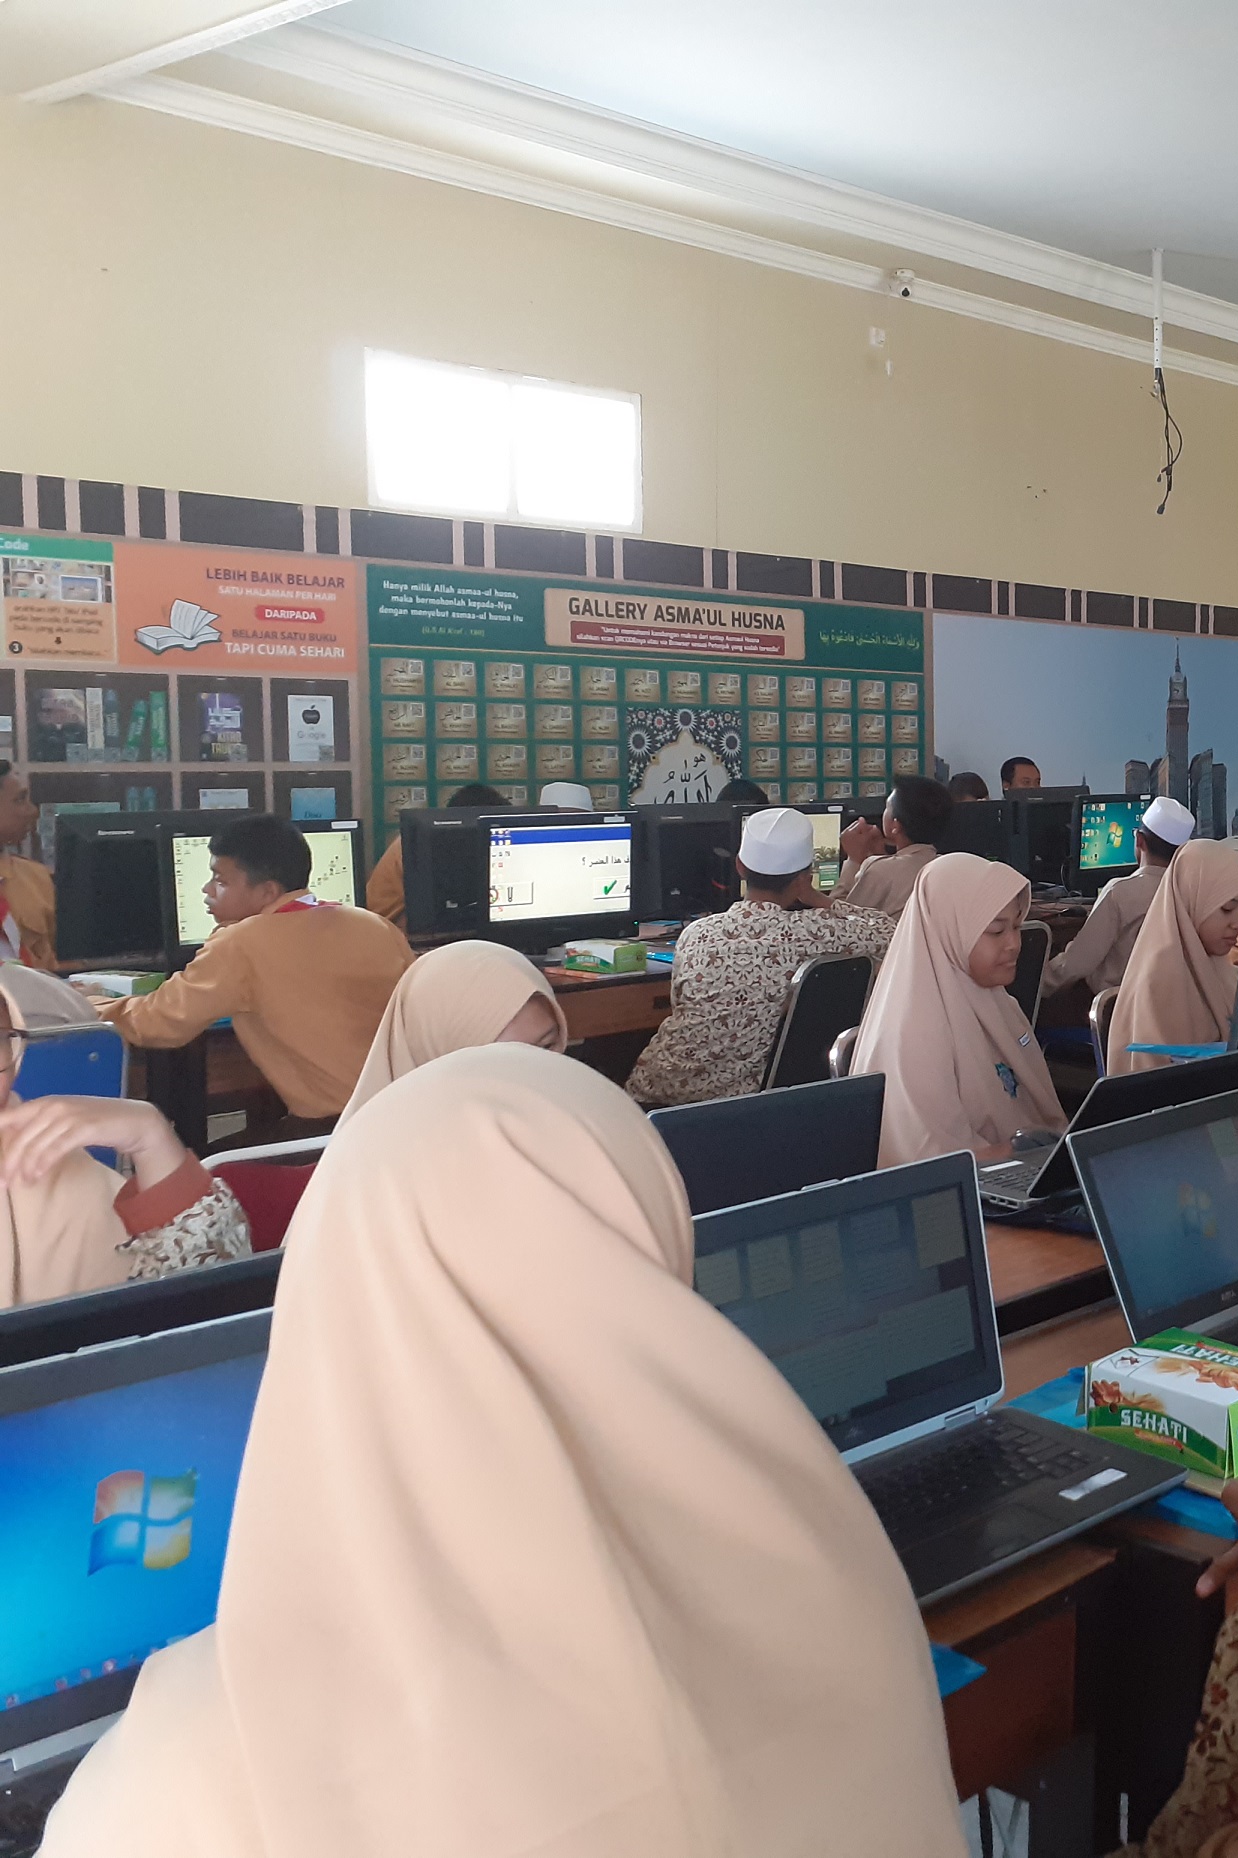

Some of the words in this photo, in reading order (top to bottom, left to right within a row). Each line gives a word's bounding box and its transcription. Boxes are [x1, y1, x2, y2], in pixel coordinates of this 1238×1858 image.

[206, 567, 247, 582] LEBIH
[251, 571, 284, 584] BAIK
[287, 573, 345, 588] BELAJAR
[218, 585, 244, 596] SATU
[245, 588, 294, 599] HALAMAN
[295, 591, 314, 600] PER
[314, 592, 337, 602] HARI
[383, 580, 408, 592] Hanya
[411, 583, 432, 592] milik
[434, 584, 455, 594] Allah
[391, 595, 413, 604] maka
[264, 608, 317, 621] DARIPADA
[379, 605, 408, 617] dengan
[568, 597, 647, 621] GALLERY
[654, 604, 727, 627] ASMA'UL
[731, 610, 786, 631] HUSNA
[232, 629, 278, 641] BELAJAR
[281, 632, 307, 641] SATU
[309, 633, 337, 643] BUKU
[225, 642, 254, 654] TAPI
[257, 644, 297, 656] CUMA
[300, 646, 345, 658] SEHARI
[1120, 1409, 1188, 1443] SEHATI
